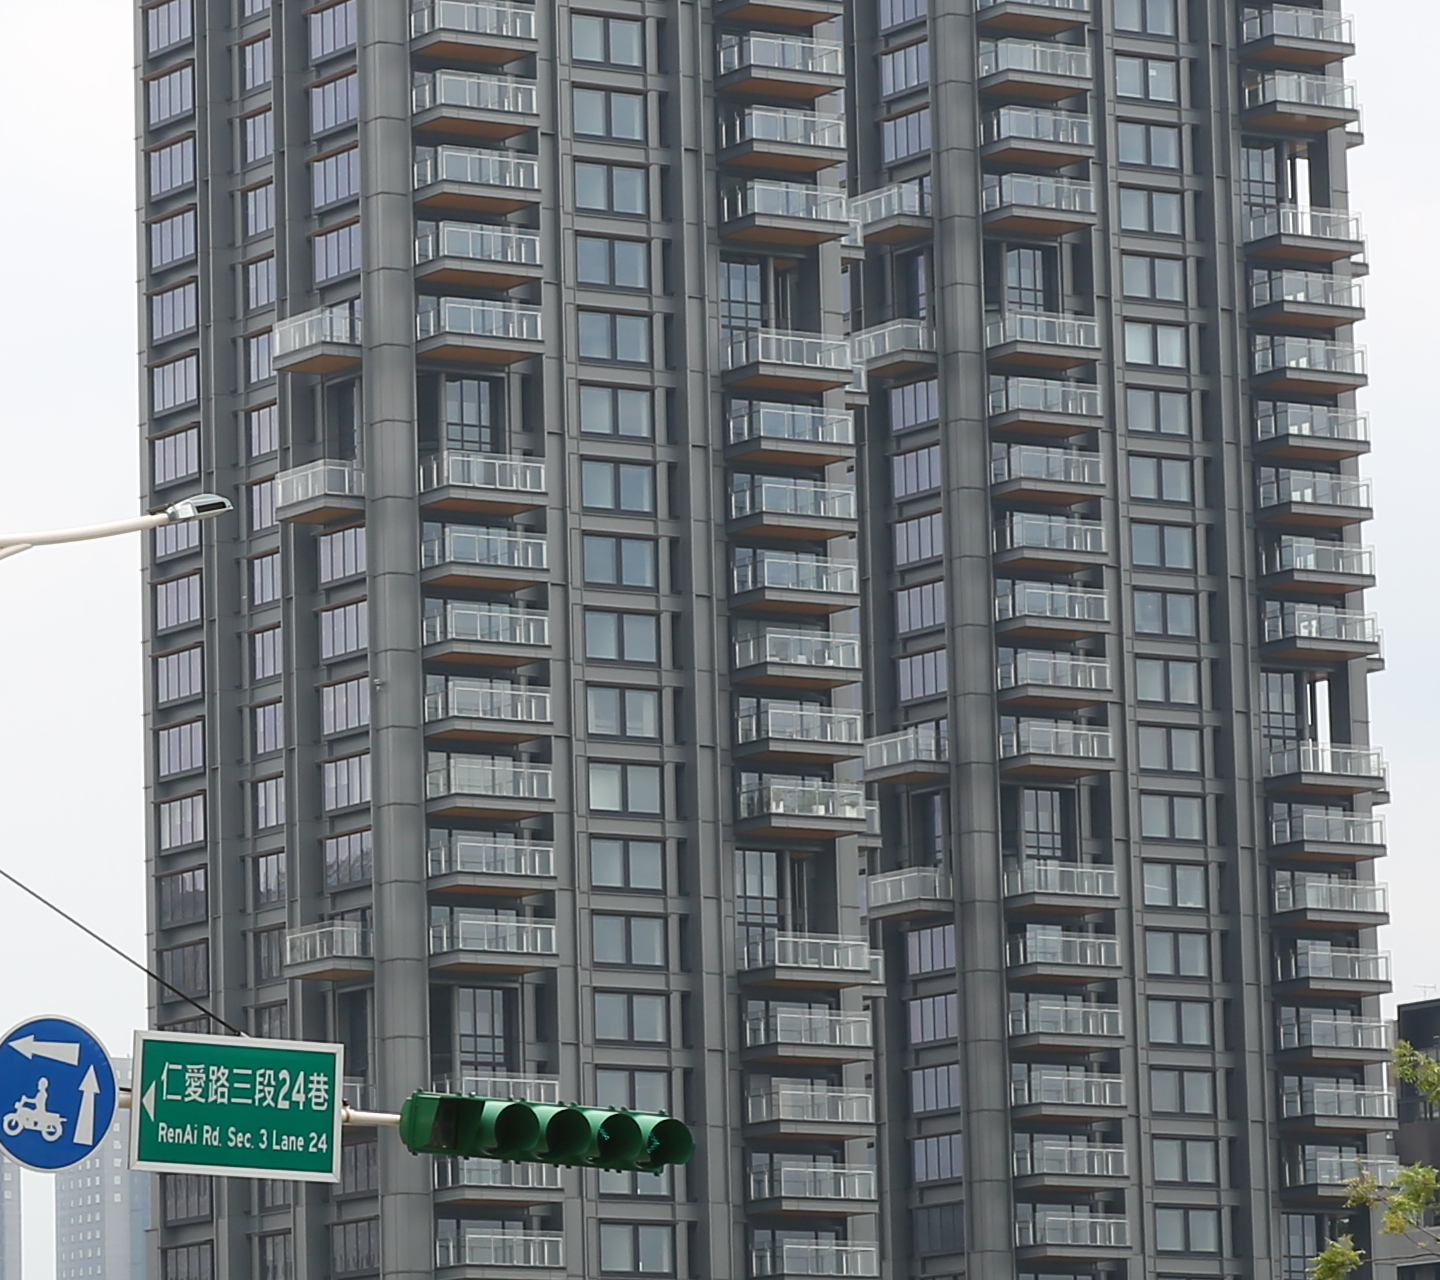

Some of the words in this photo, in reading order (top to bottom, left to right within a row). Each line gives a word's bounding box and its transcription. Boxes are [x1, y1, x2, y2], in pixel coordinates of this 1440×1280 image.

[161, 1061, 329, 1111] 仁愛路三段24巷
[158, 1122, 197, 1145] RenAi
[202, 1125, 222, 1147] Rd.
[227, 1127, 254, 1149] Sec.
[259, 1129, 268, 1150] 3
[272, 1130, 304, 1151] Lane
[309, 1132, 327, 1154] 24
